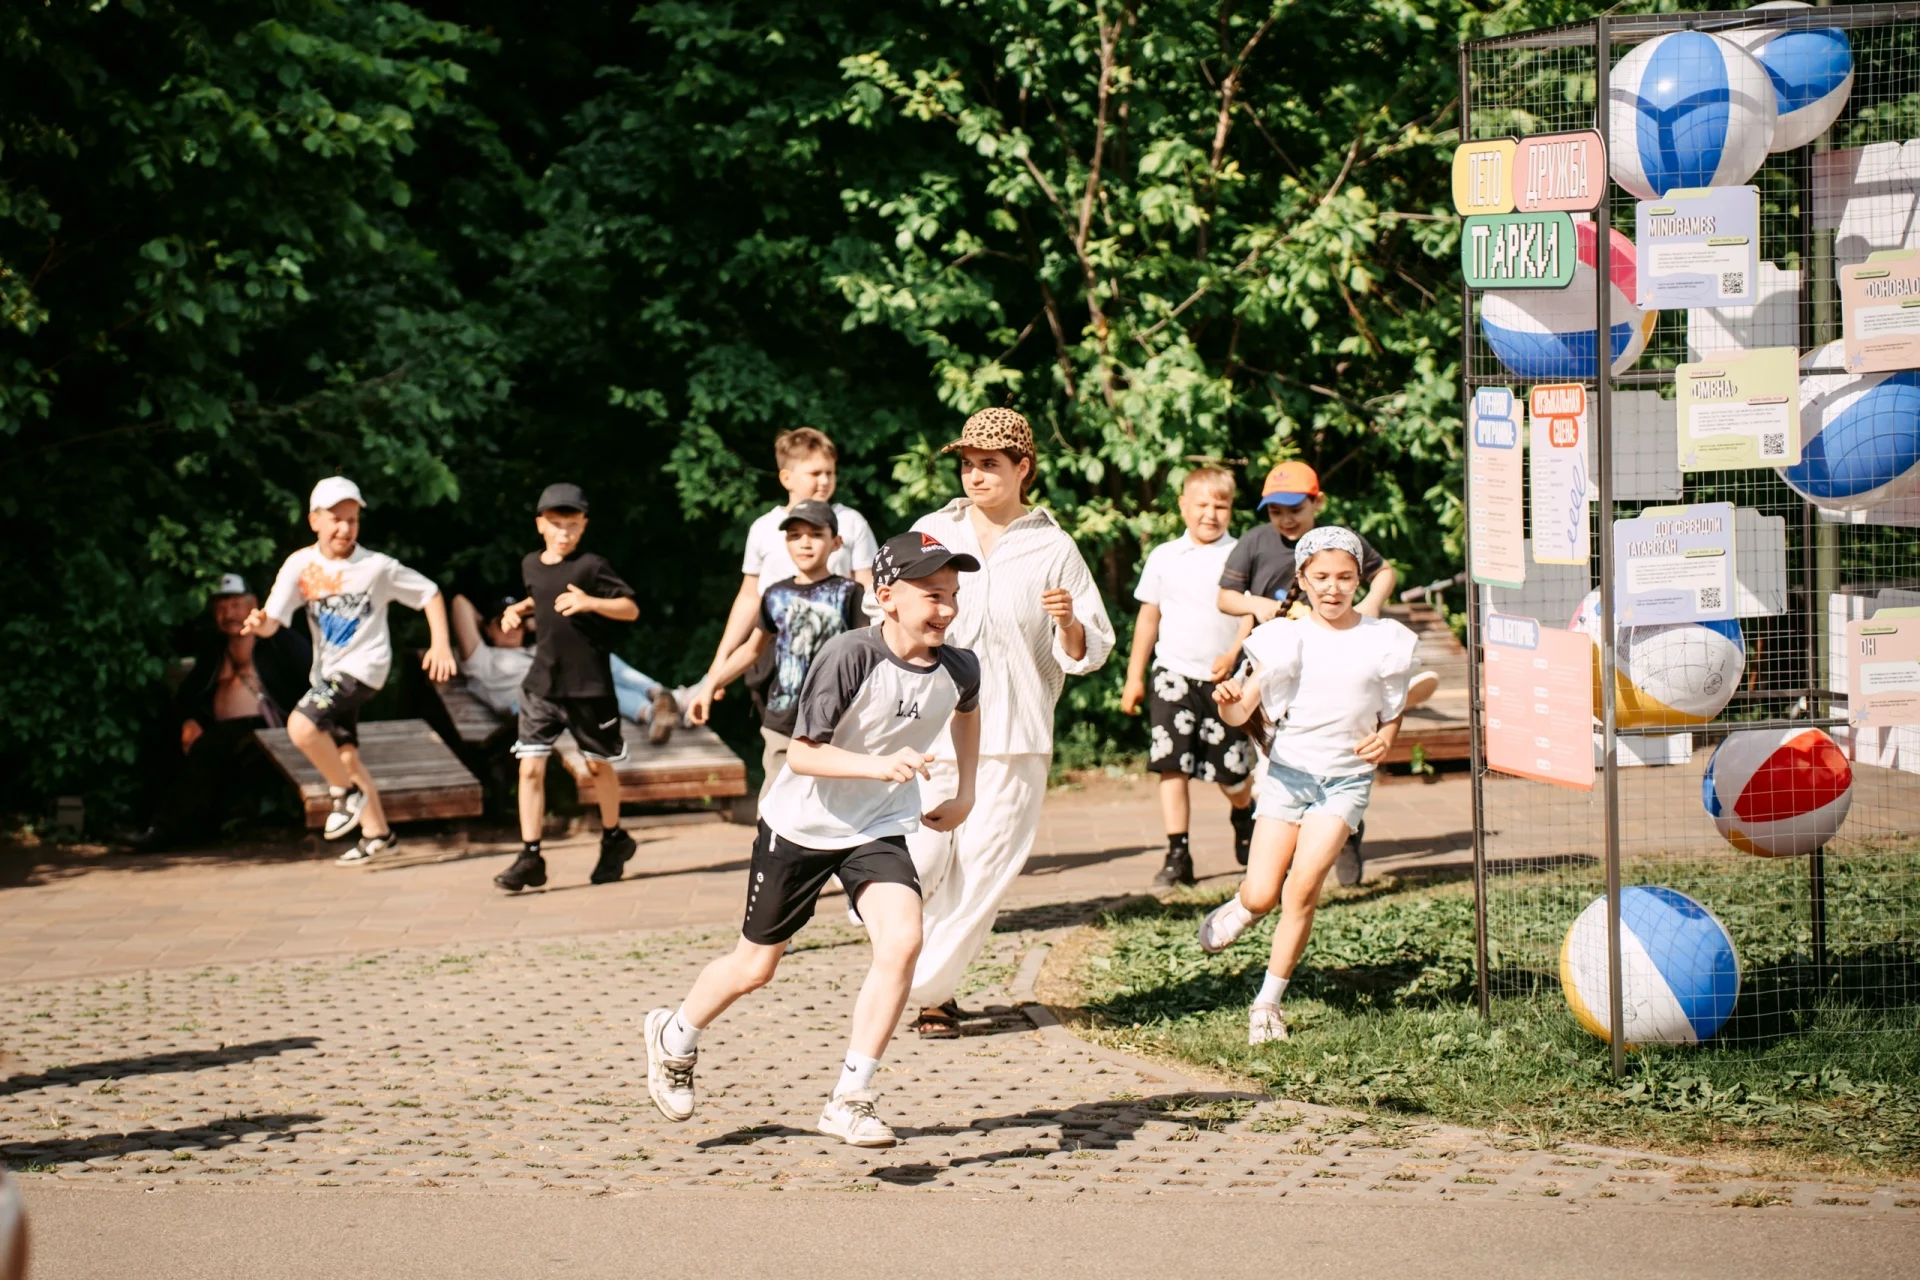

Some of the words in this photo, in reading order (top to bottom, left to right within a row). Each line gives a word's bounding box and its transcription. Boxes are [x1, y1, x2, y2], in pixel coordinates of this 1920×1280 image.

[1468, 150, 1502, 207] ЛЕТО
[1525, 140, 1588, 208] ДРУЖБА
[1648, 216, 1716, 237] MINDGAMES
[1471, 221, 1560, 279] ПАРКИ
[1655, 521, 1674, 538] ДОГ
[1675, 518, 1722, 536] ФРЕНДЛИ
[1626, 539, 1678, 557] ТАТАРСТАН
